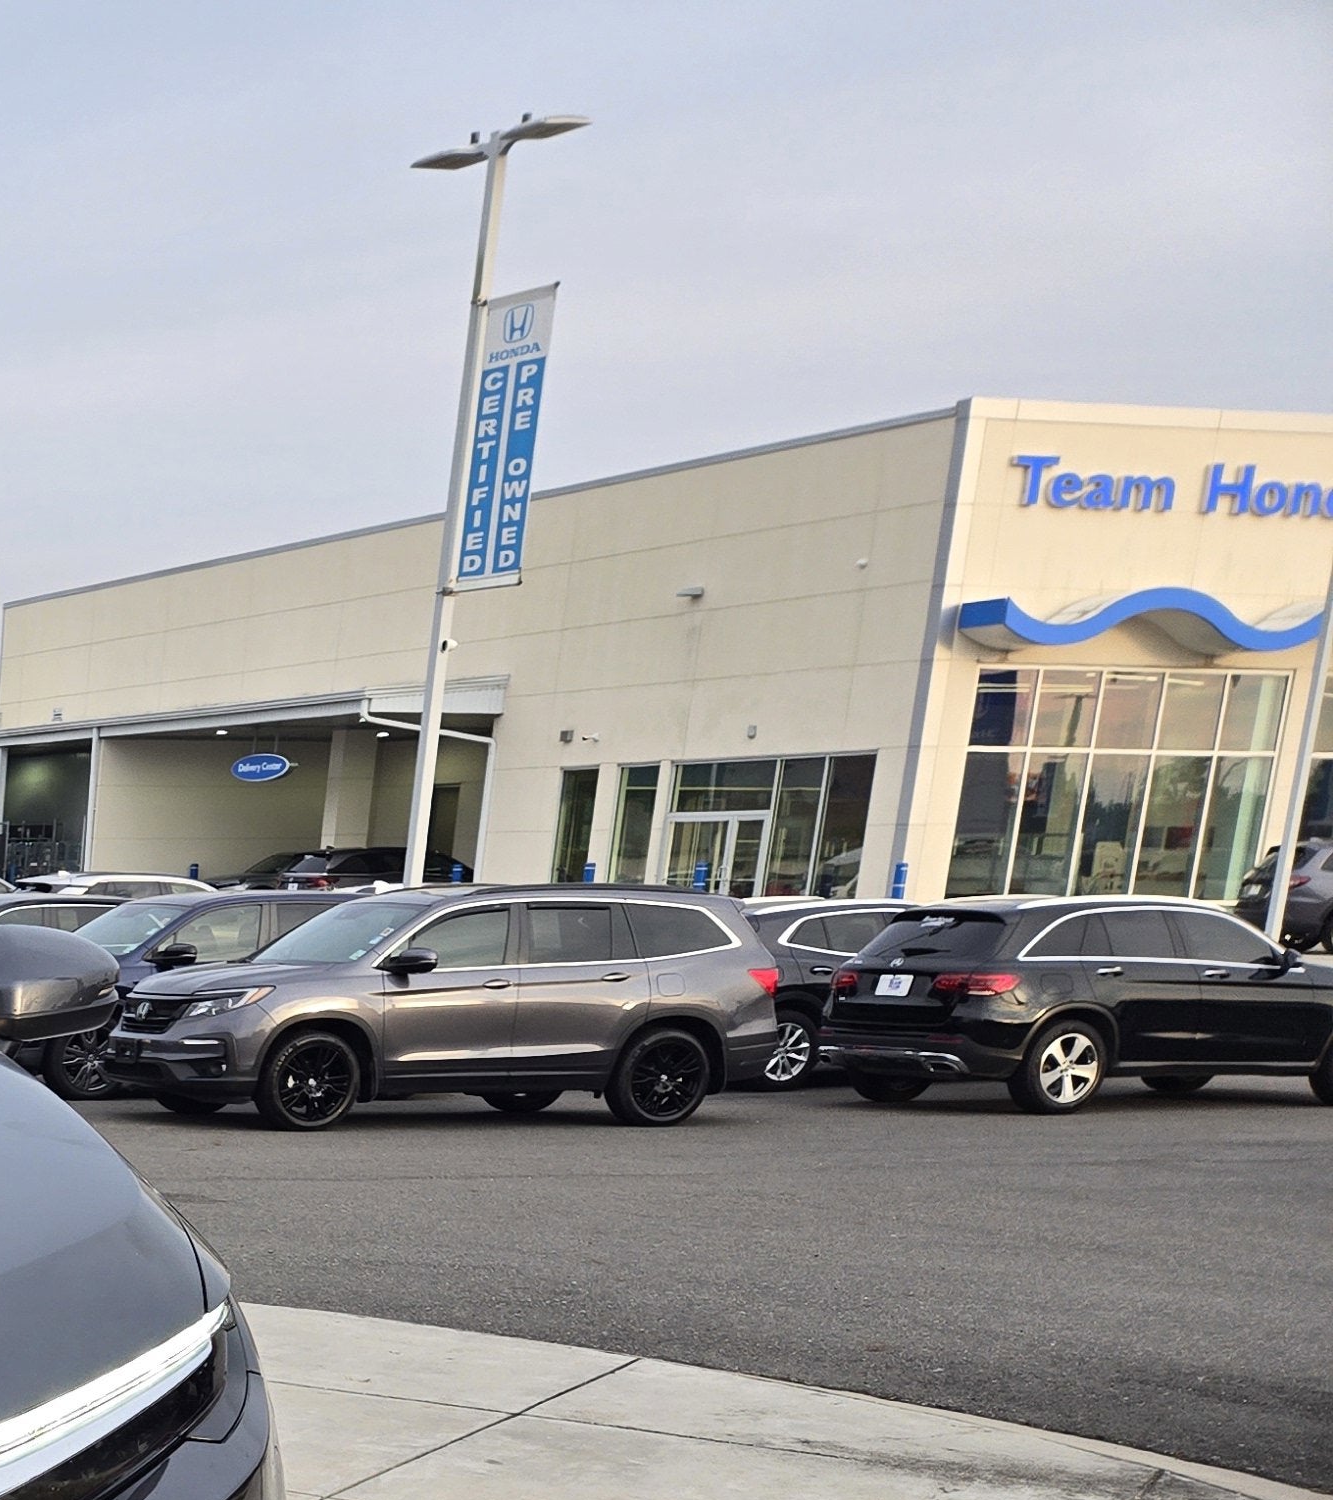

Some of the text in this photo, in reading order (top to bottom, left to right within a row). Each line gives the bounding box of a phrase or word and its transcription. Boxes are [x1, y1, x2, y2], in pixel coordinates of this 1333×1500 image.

[488, 341, 541, 364] HONDA
[463, 371, 504, 573] CERTIFIED
[498, 363, 538, 568] PRE OWNED
[1011, 455, 1176, 512] Team
[261, 761, 282, 772] Center
